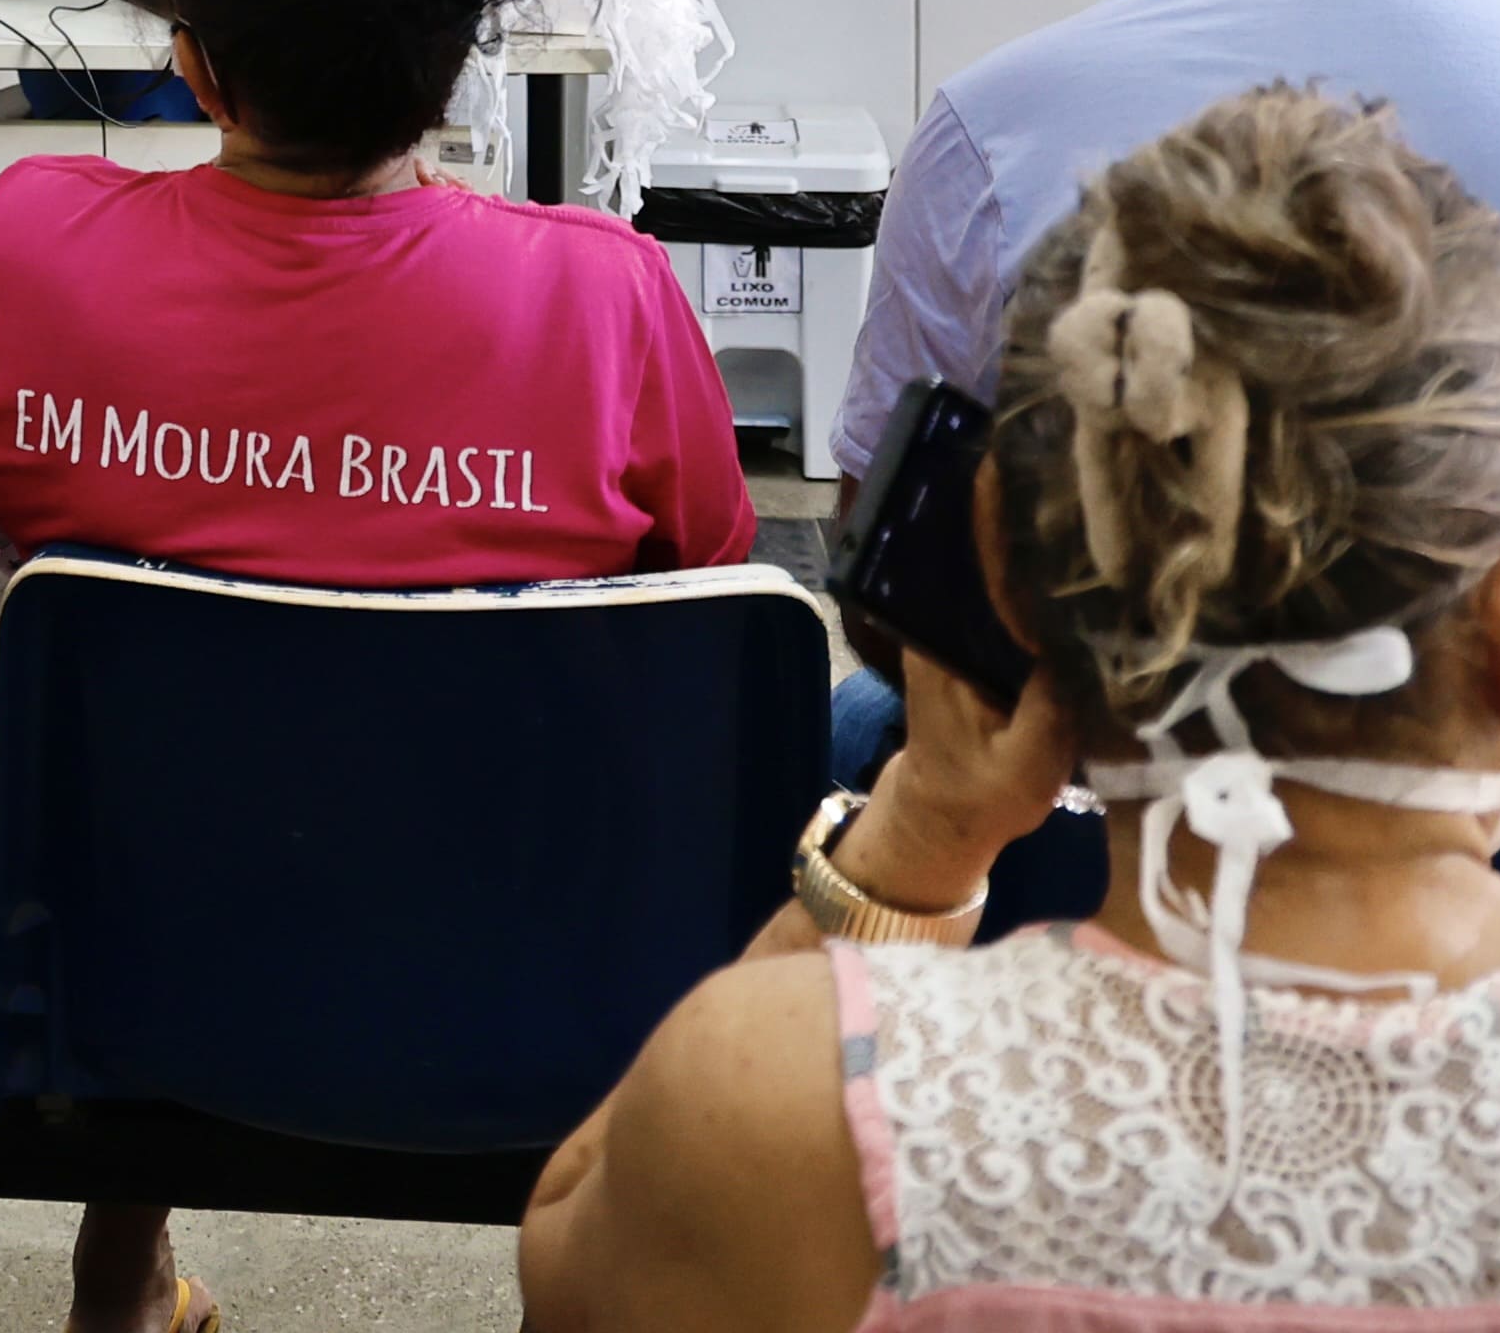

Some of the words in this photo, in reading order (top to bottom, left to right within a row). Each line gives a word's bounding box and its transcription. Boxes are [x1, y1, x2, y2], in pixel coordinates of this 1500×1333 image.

[731, 282, 775, 293] LIXO
[716, 295, 789, 308] COMUM
[14, 388, 83, 465] EM
[99, 405, 316, 494] MOURA
[339, 434, 549, 514] BRASIL
